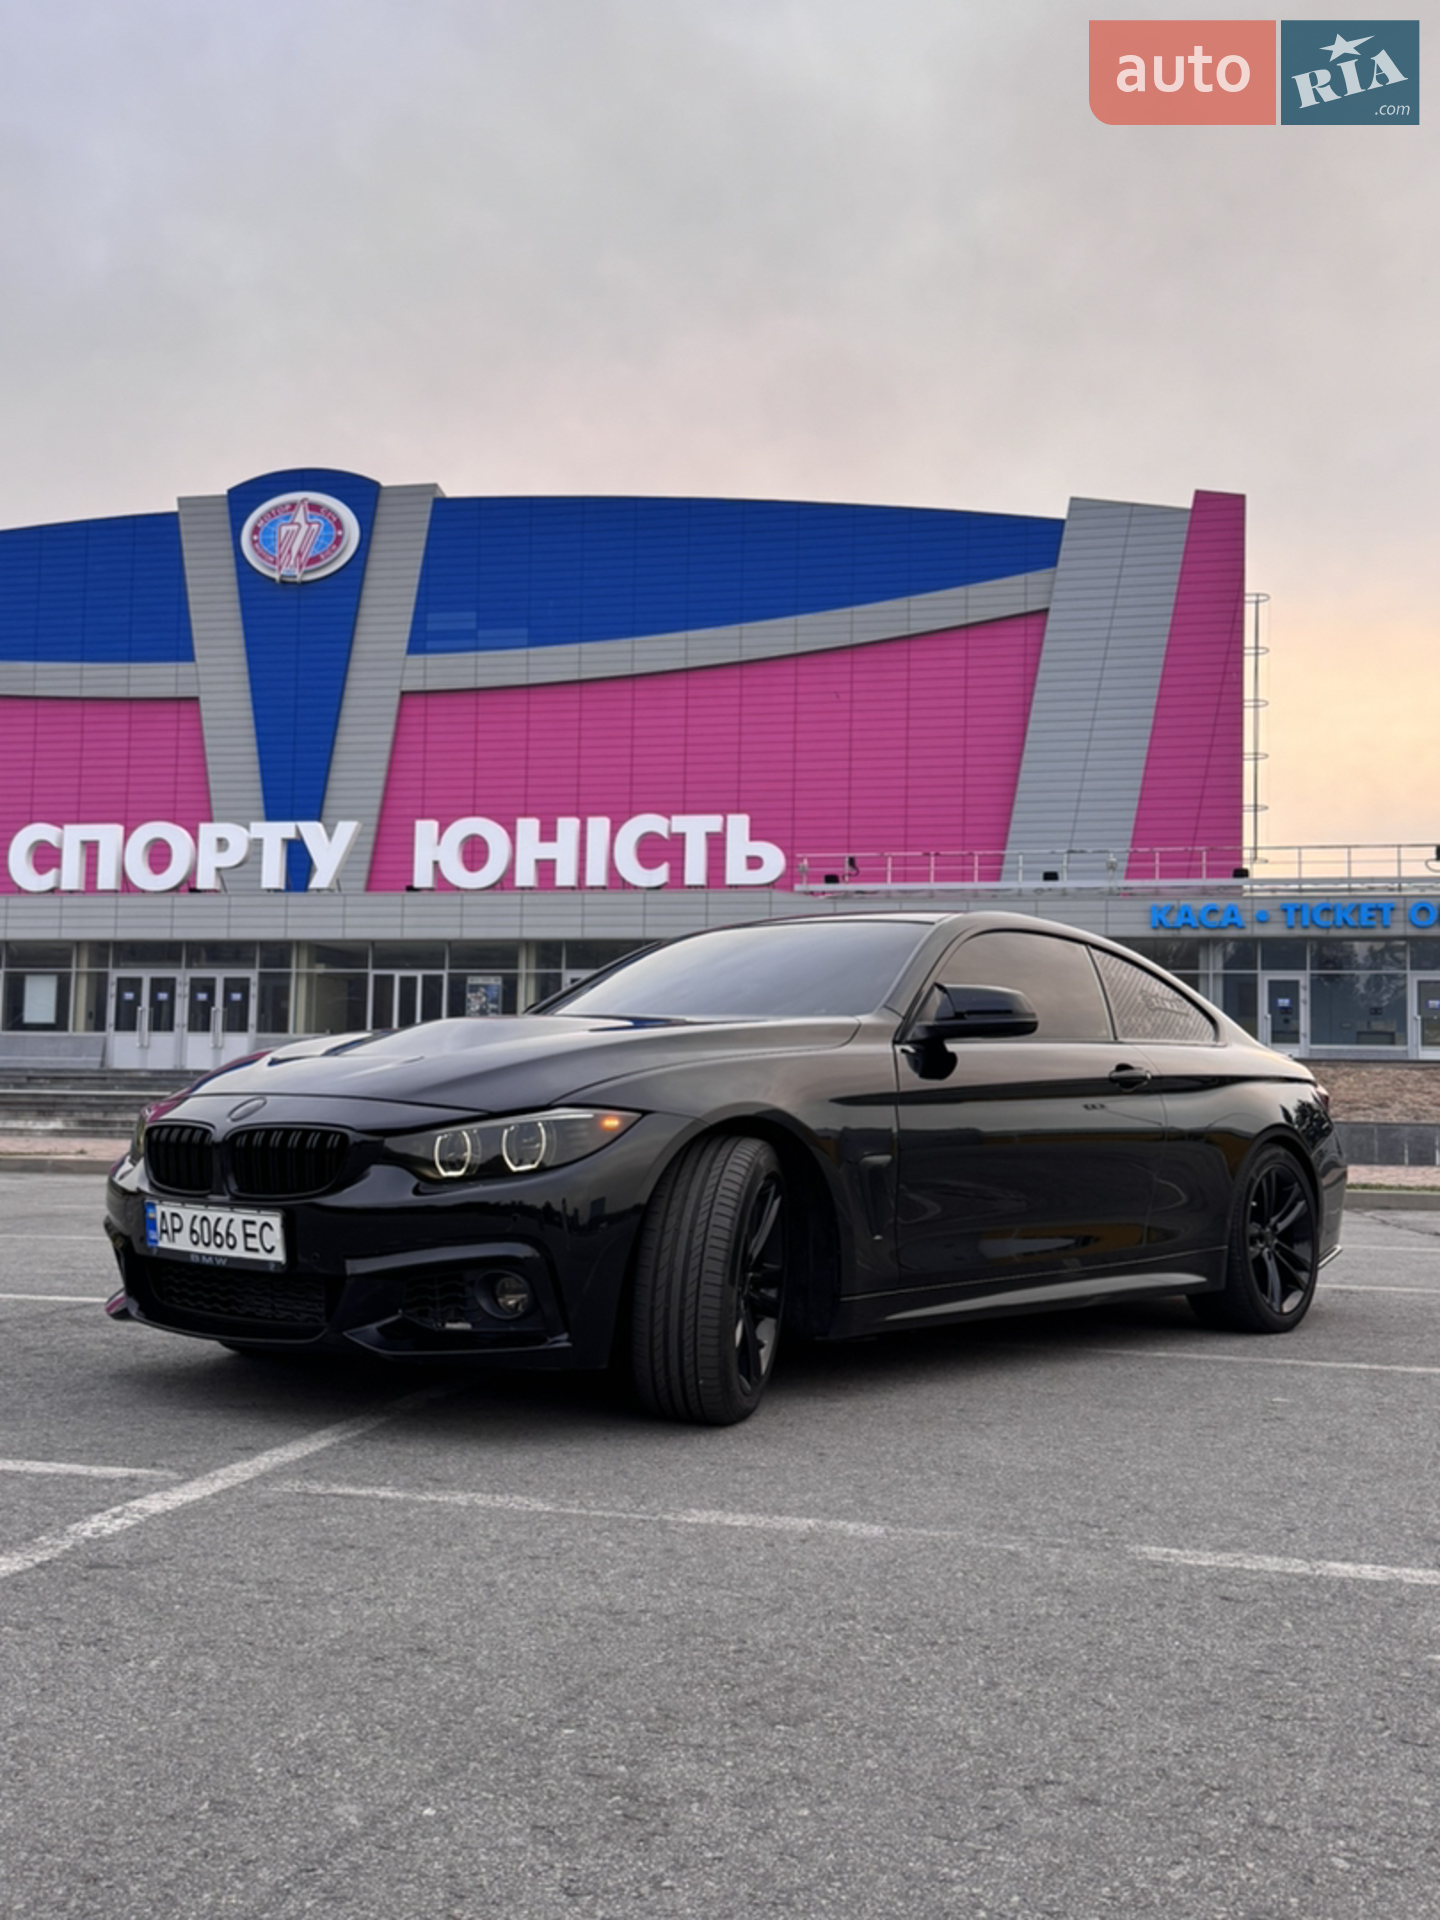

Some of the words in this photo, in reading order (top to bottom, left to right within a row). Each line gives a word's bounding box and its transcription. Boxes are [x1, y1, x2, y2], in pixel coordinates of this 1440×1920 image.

[7, 821, 361, 892] СПОРТУ
[412, 813, 787, 890] ЮНІСТЬ
[1150, 902, 1246, 930] КАСА
[1279, 902, 1396, 929] TICKET
[1408, 900, 1440, 929] O
[159, 1210, 184, 1243] AP
[189, 1214, 237, 1250] 6066
[241, 1219, 276, 1254] EC
